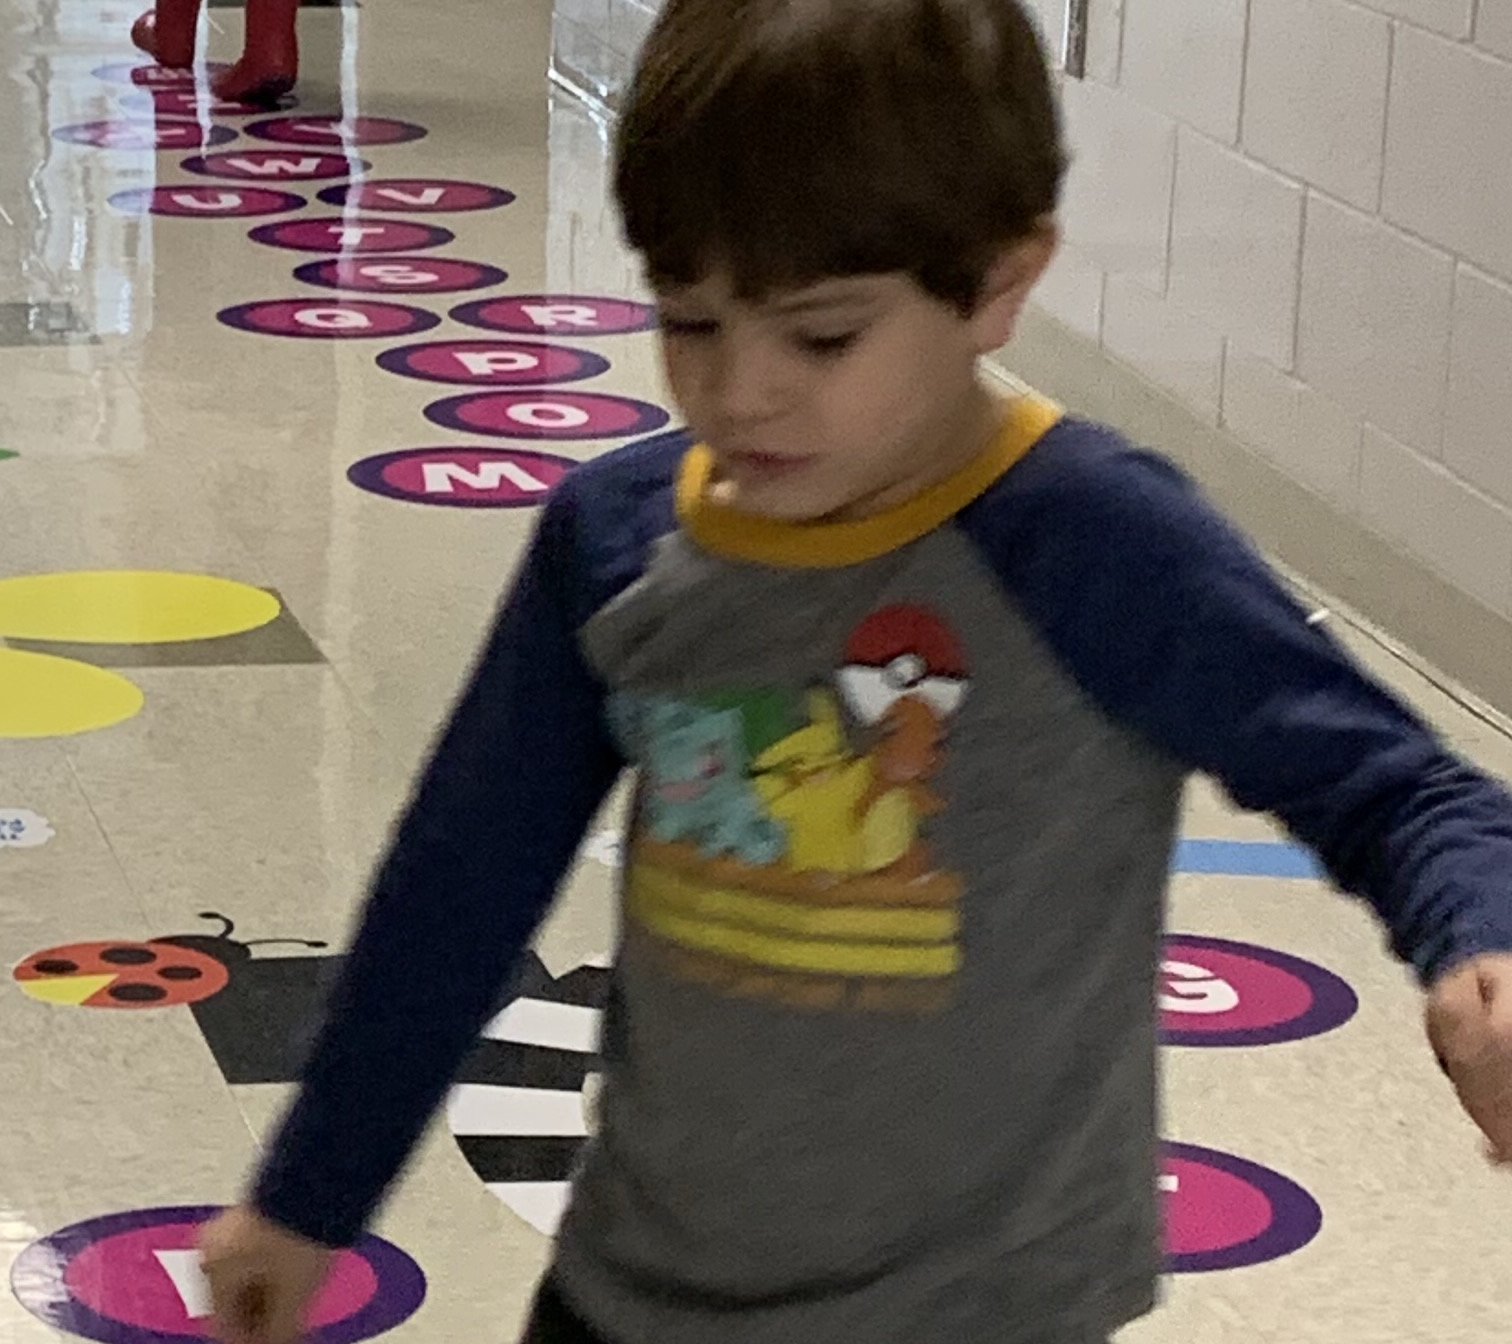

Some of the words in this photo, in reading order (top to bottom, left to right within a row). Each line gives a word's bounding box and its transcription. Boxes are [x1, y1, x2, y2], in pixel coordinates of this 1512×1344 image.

[226, 157, 322, 175] W
[171, 192, 243, 210] U
[376, 188, 445, 205] V
[328, 226, 385, 246] T
[359, 264, 439, 285] S
[293, 308, 372, 329] Q
[520, 305, 599, 327] R
[452, 351, 540, 376] P
[506, 402, 590, 428] O
[421, 461, 548, 493] M
